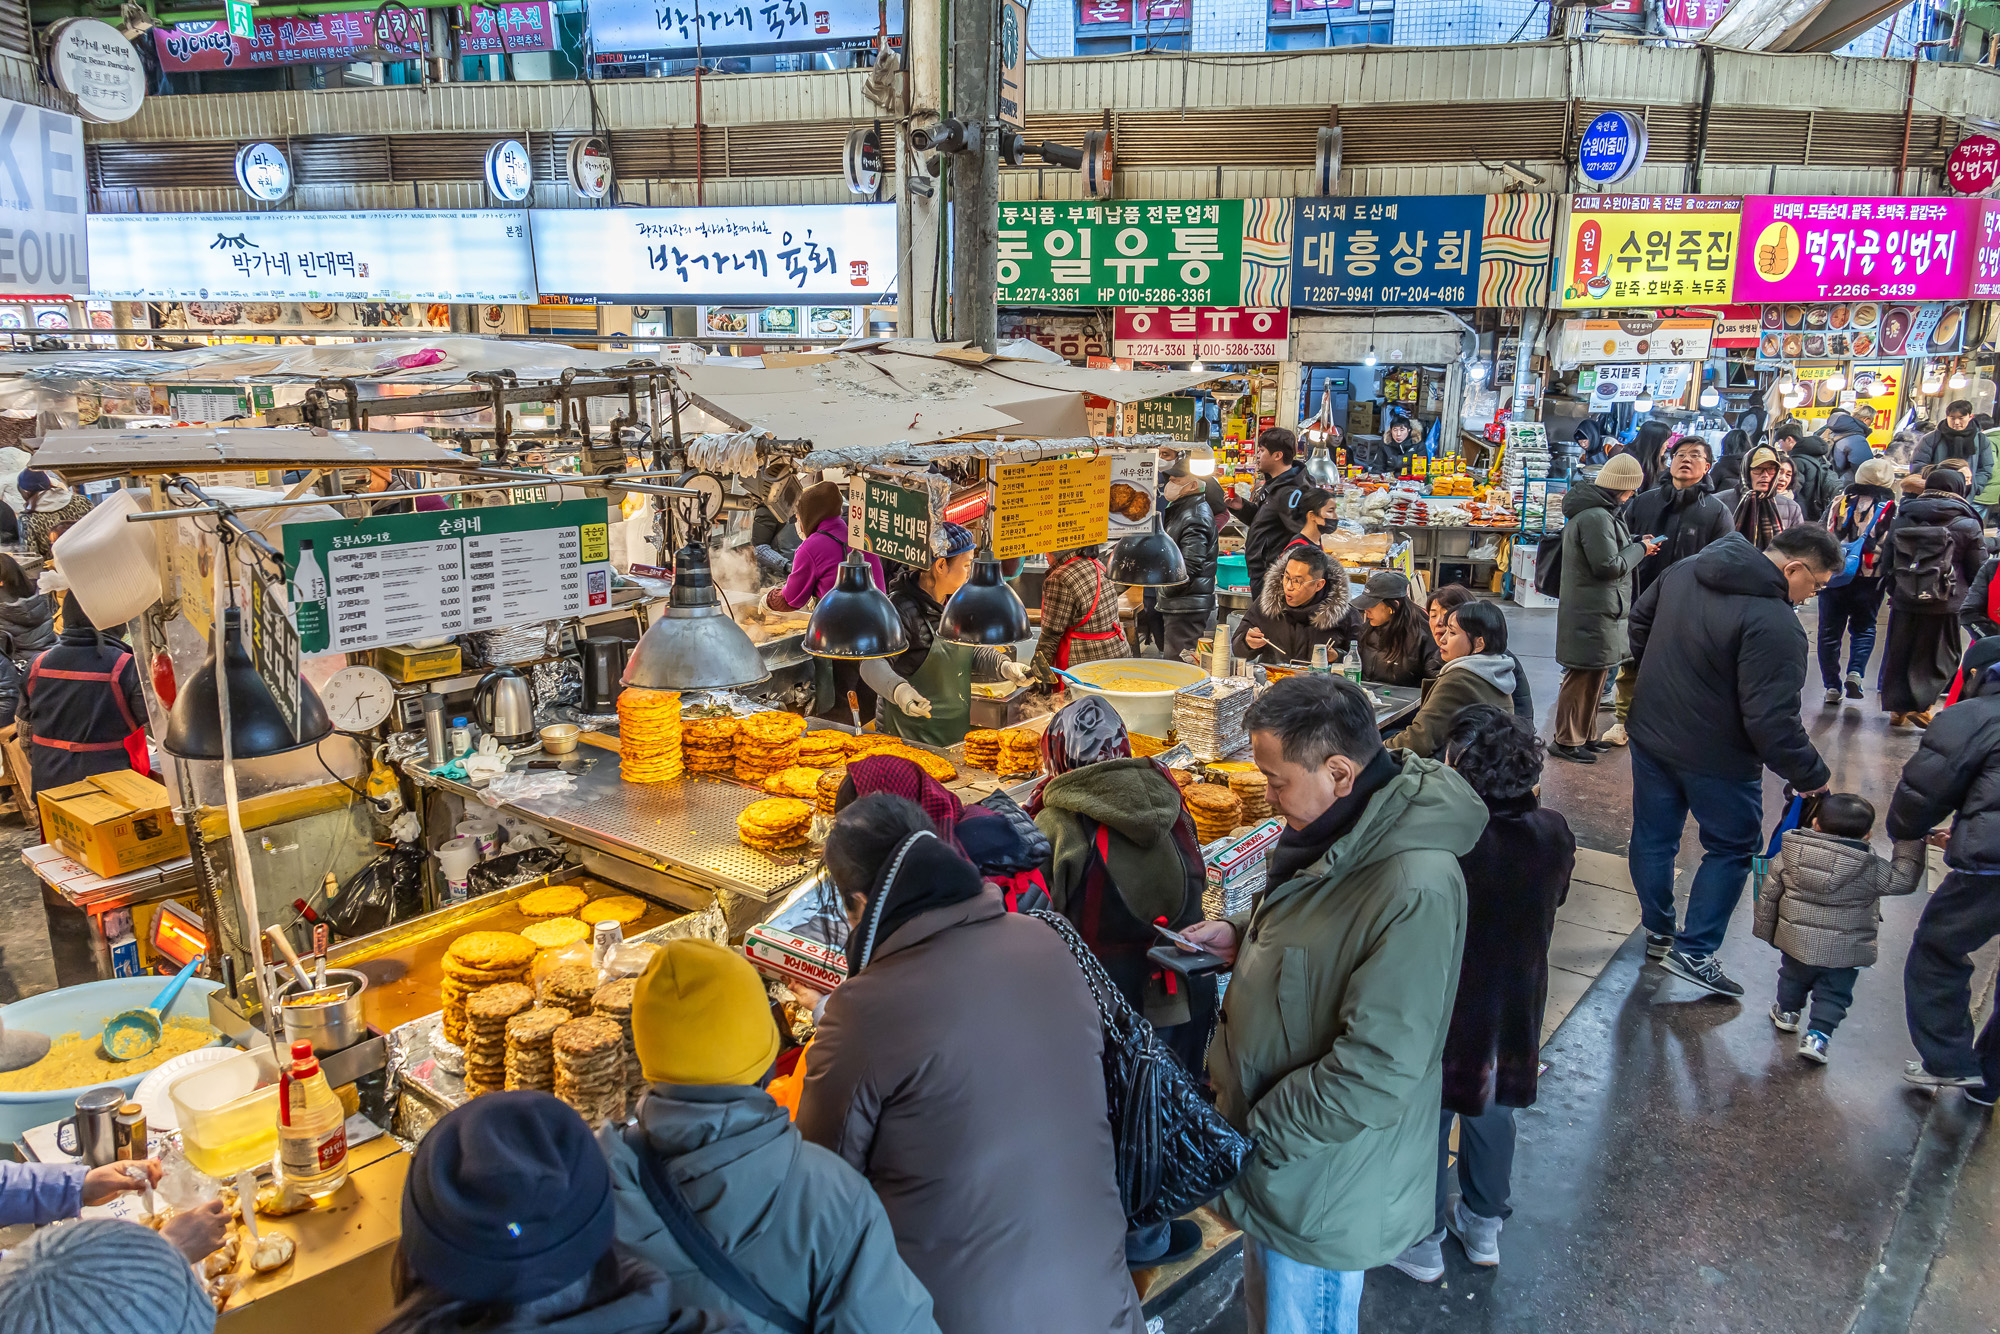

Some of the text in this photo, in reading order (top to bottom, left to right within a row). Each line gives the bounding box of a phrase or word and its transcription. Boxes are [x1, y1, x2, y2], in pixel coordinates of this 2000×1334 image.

[279, 22, 327, 46] 패스트
[331, 19, 363, 43] 푸드
[475, 6, 543, 35] 강력추천
[656, 6, 753, 39] 박가네
[70, 36, 129, 58] 박가네 빈대떡
[166, 31, 234, 67] 빈대떡
[66, 52, 136, 73] Mung Bean Pancake
[250, 50, 273, 63] 세계적
[596, 53, 624, 64] NETFLIX
[1582, 136, 1627, 157] 수원아줌마
[1960, 143, 1996, 158] 먹자골
[1951, 159, 1999, 181] 일번지
[1574, 197, 1683, 210] 2대째 수원아줌마 죽 전문
[1146, 204, 1220, 225] 전문업체
[1302, 203, 1399, 221] 식자재 도산매
[506, 225, 523, 238] 본점
[998, 227, 1224, 286] 동일유통
[1302, 229, 1471, 277] 대흥상회
[1579, 229, 1596, 275] 원조
[1617, 230, 1732, 273] 수원죽집
[233, 251, 356, 278] 박가네 빈대떡
[648, 244, 768, 283] 박가네
[777, 229, 837, 289] 육회
[998, 287, 1211, 302] EL.2274-3361 HP 010-5286-3361
[1304, 286, 1465, 302] T 2267-9941 017-204-4816
[1817, 283, 1916, 297] T.2266-3439
[540, 295, 569, 305] NETFLIX
[1126, 344, 1186, 356] T.2274-3361
[1600, 367, 1640, 379] 동지팥죽
[1800, 370, 1813, 378] 40년
[1144, 402, 1172, 412] 박가네
[1126, 414, 1134, 424] 58
[1127, 426, 1134, 434] 호
[1120, 468, 1153, 477] 새우완자
[871, 487, 898, 508] 박가네
[851, 505, 863, 520] 59
[1037, 509, 1053, 517] 15,000
[438, 515, 481, 536] 순희네
[584, 527, 605, 537] 국순당
[852, 524, 860, 538] 호
[893, 513, 928, 544] 빈대떡
[331, 532, 391, 549] 동부A59-1호
[558, 531, 576, 539] 21,000
[436, 543, 457, 552] 27,000
[558, 541, 577, 549] 10,000
[875, 537, 927, 564] 2267-0614
[558, 551, 577, 560] 35,000
[438, 562, 458, 572] 13,000
[560, 562, 577, 570] 17,000
[441, 574, 459, 583] 5,000
[560, 572, 578, 581] 15,000
[441, 586, 459, 594] 6,000
[560, 582, 578, 591] 15,000
[440, 598, 460, 607] 10,000
[563, 592, 579, 601] 4,000
[440, 609, 461, 618] 10,000
[563, 603, 579, 611] 3,000
[441, 621, 461, 630] 15,000
[783, 954, 841, 985] COOKING FOIL
